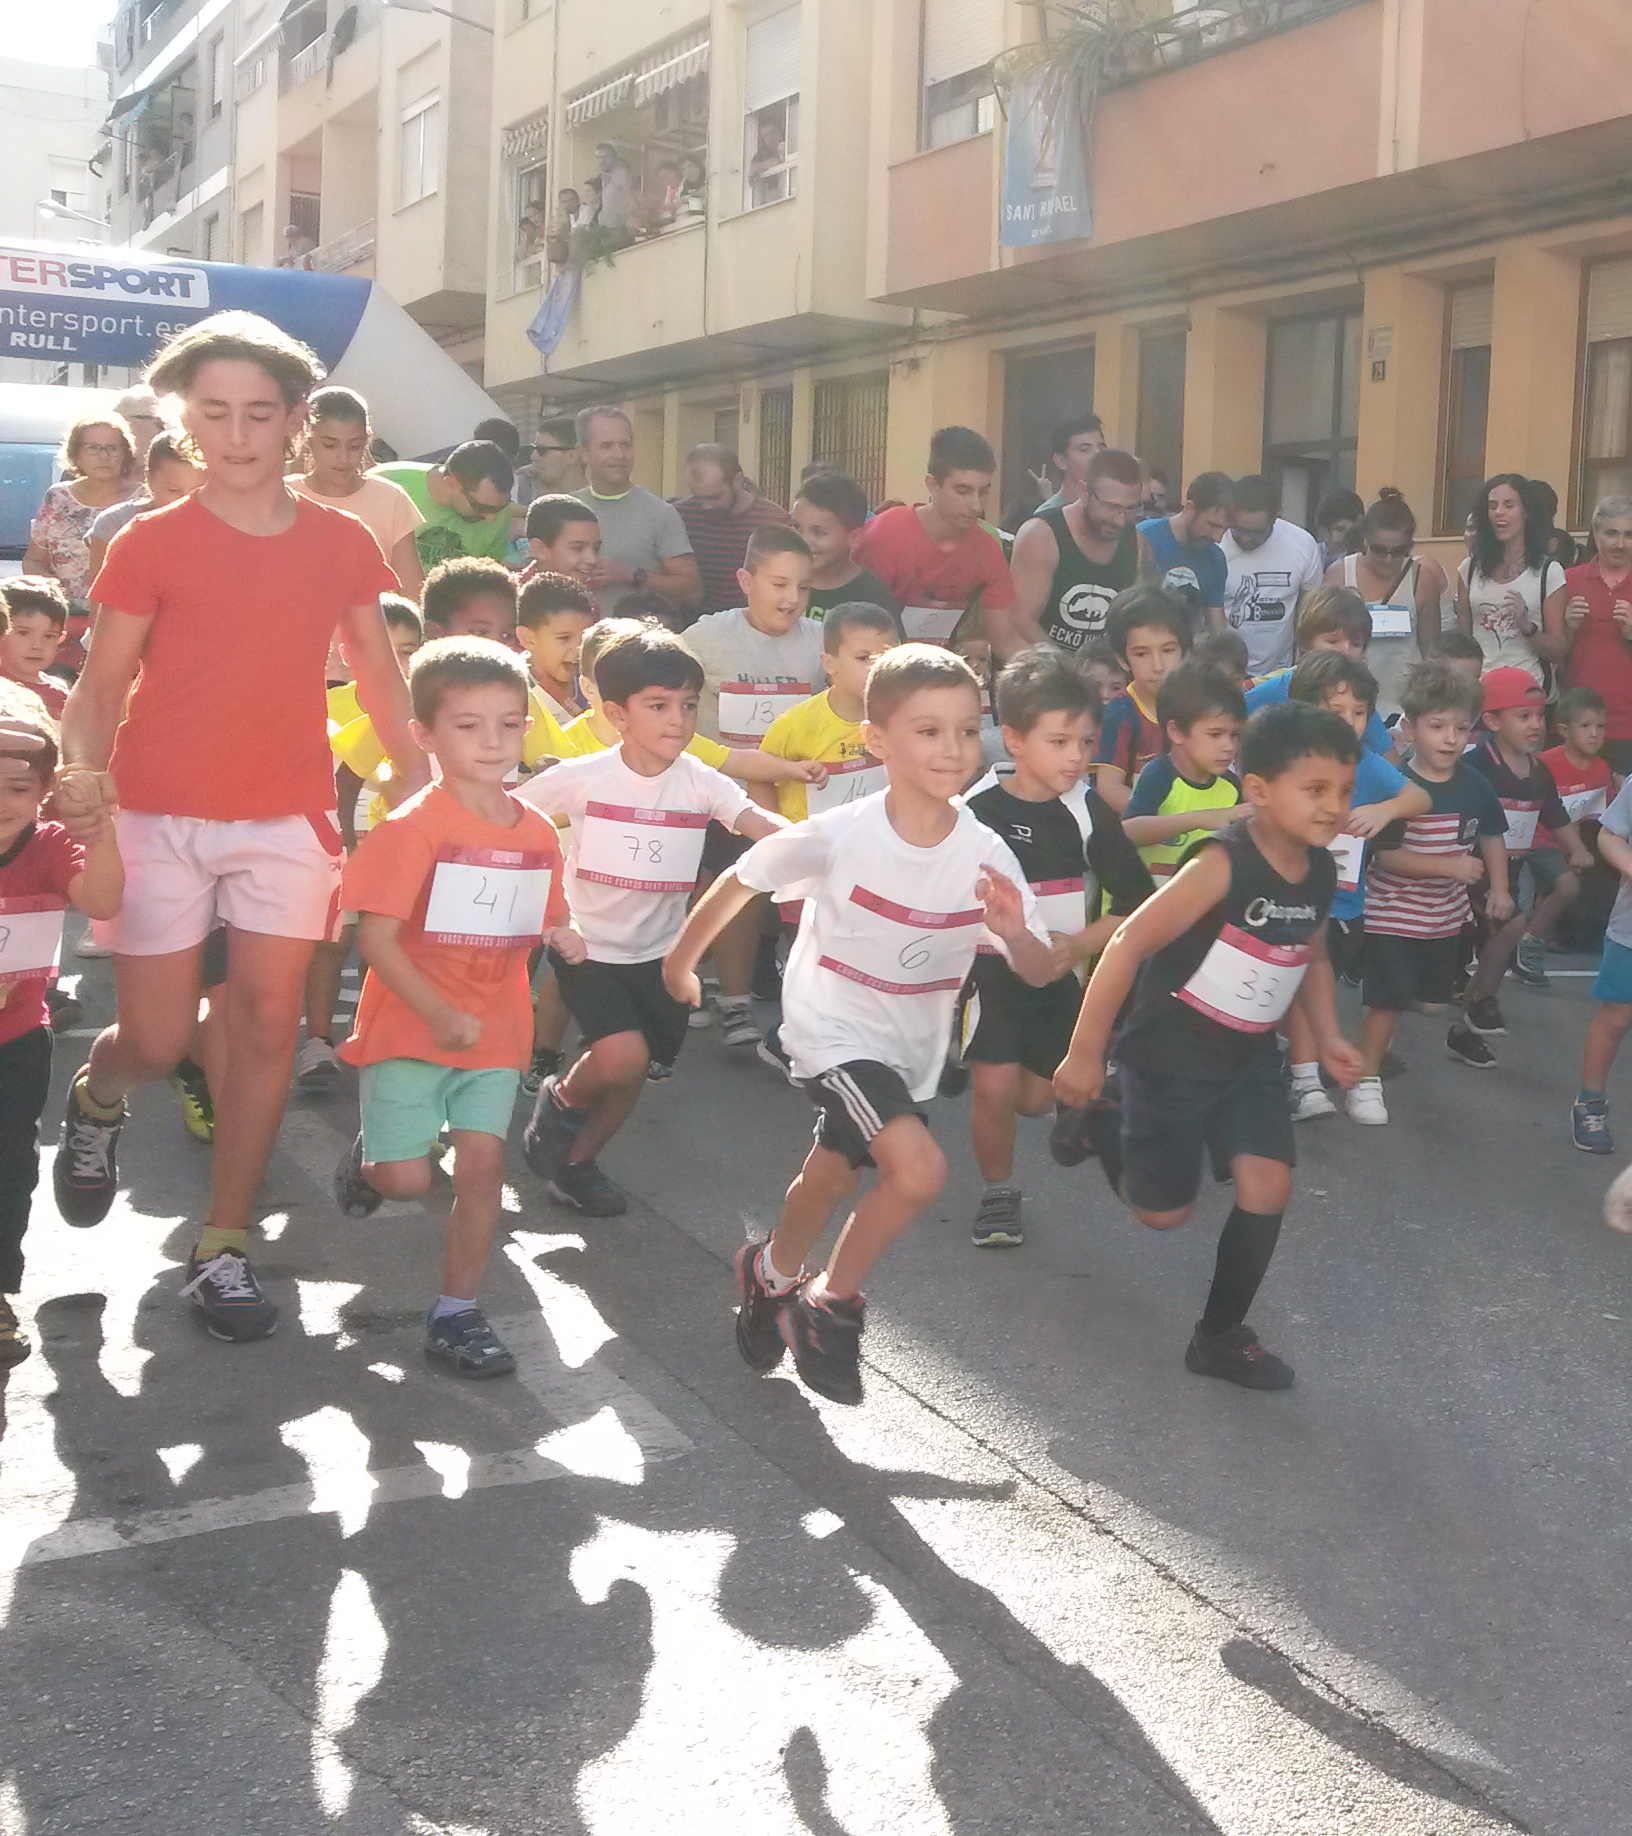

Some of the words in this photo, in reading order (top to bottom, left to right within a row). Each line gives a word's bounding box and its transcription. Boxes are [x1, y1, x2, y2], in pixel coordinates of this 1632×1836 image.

[1006, 204, 1036, 220] SANT
[10, 331, 77, 351] RULL
[745, 701, 775, 727] 13
[623, 835, 664, 863] 78
[472, 876, 519, 923] 41
[899, 934, 934, 970] 6
[1235, 969, 1280, 1008] 33
